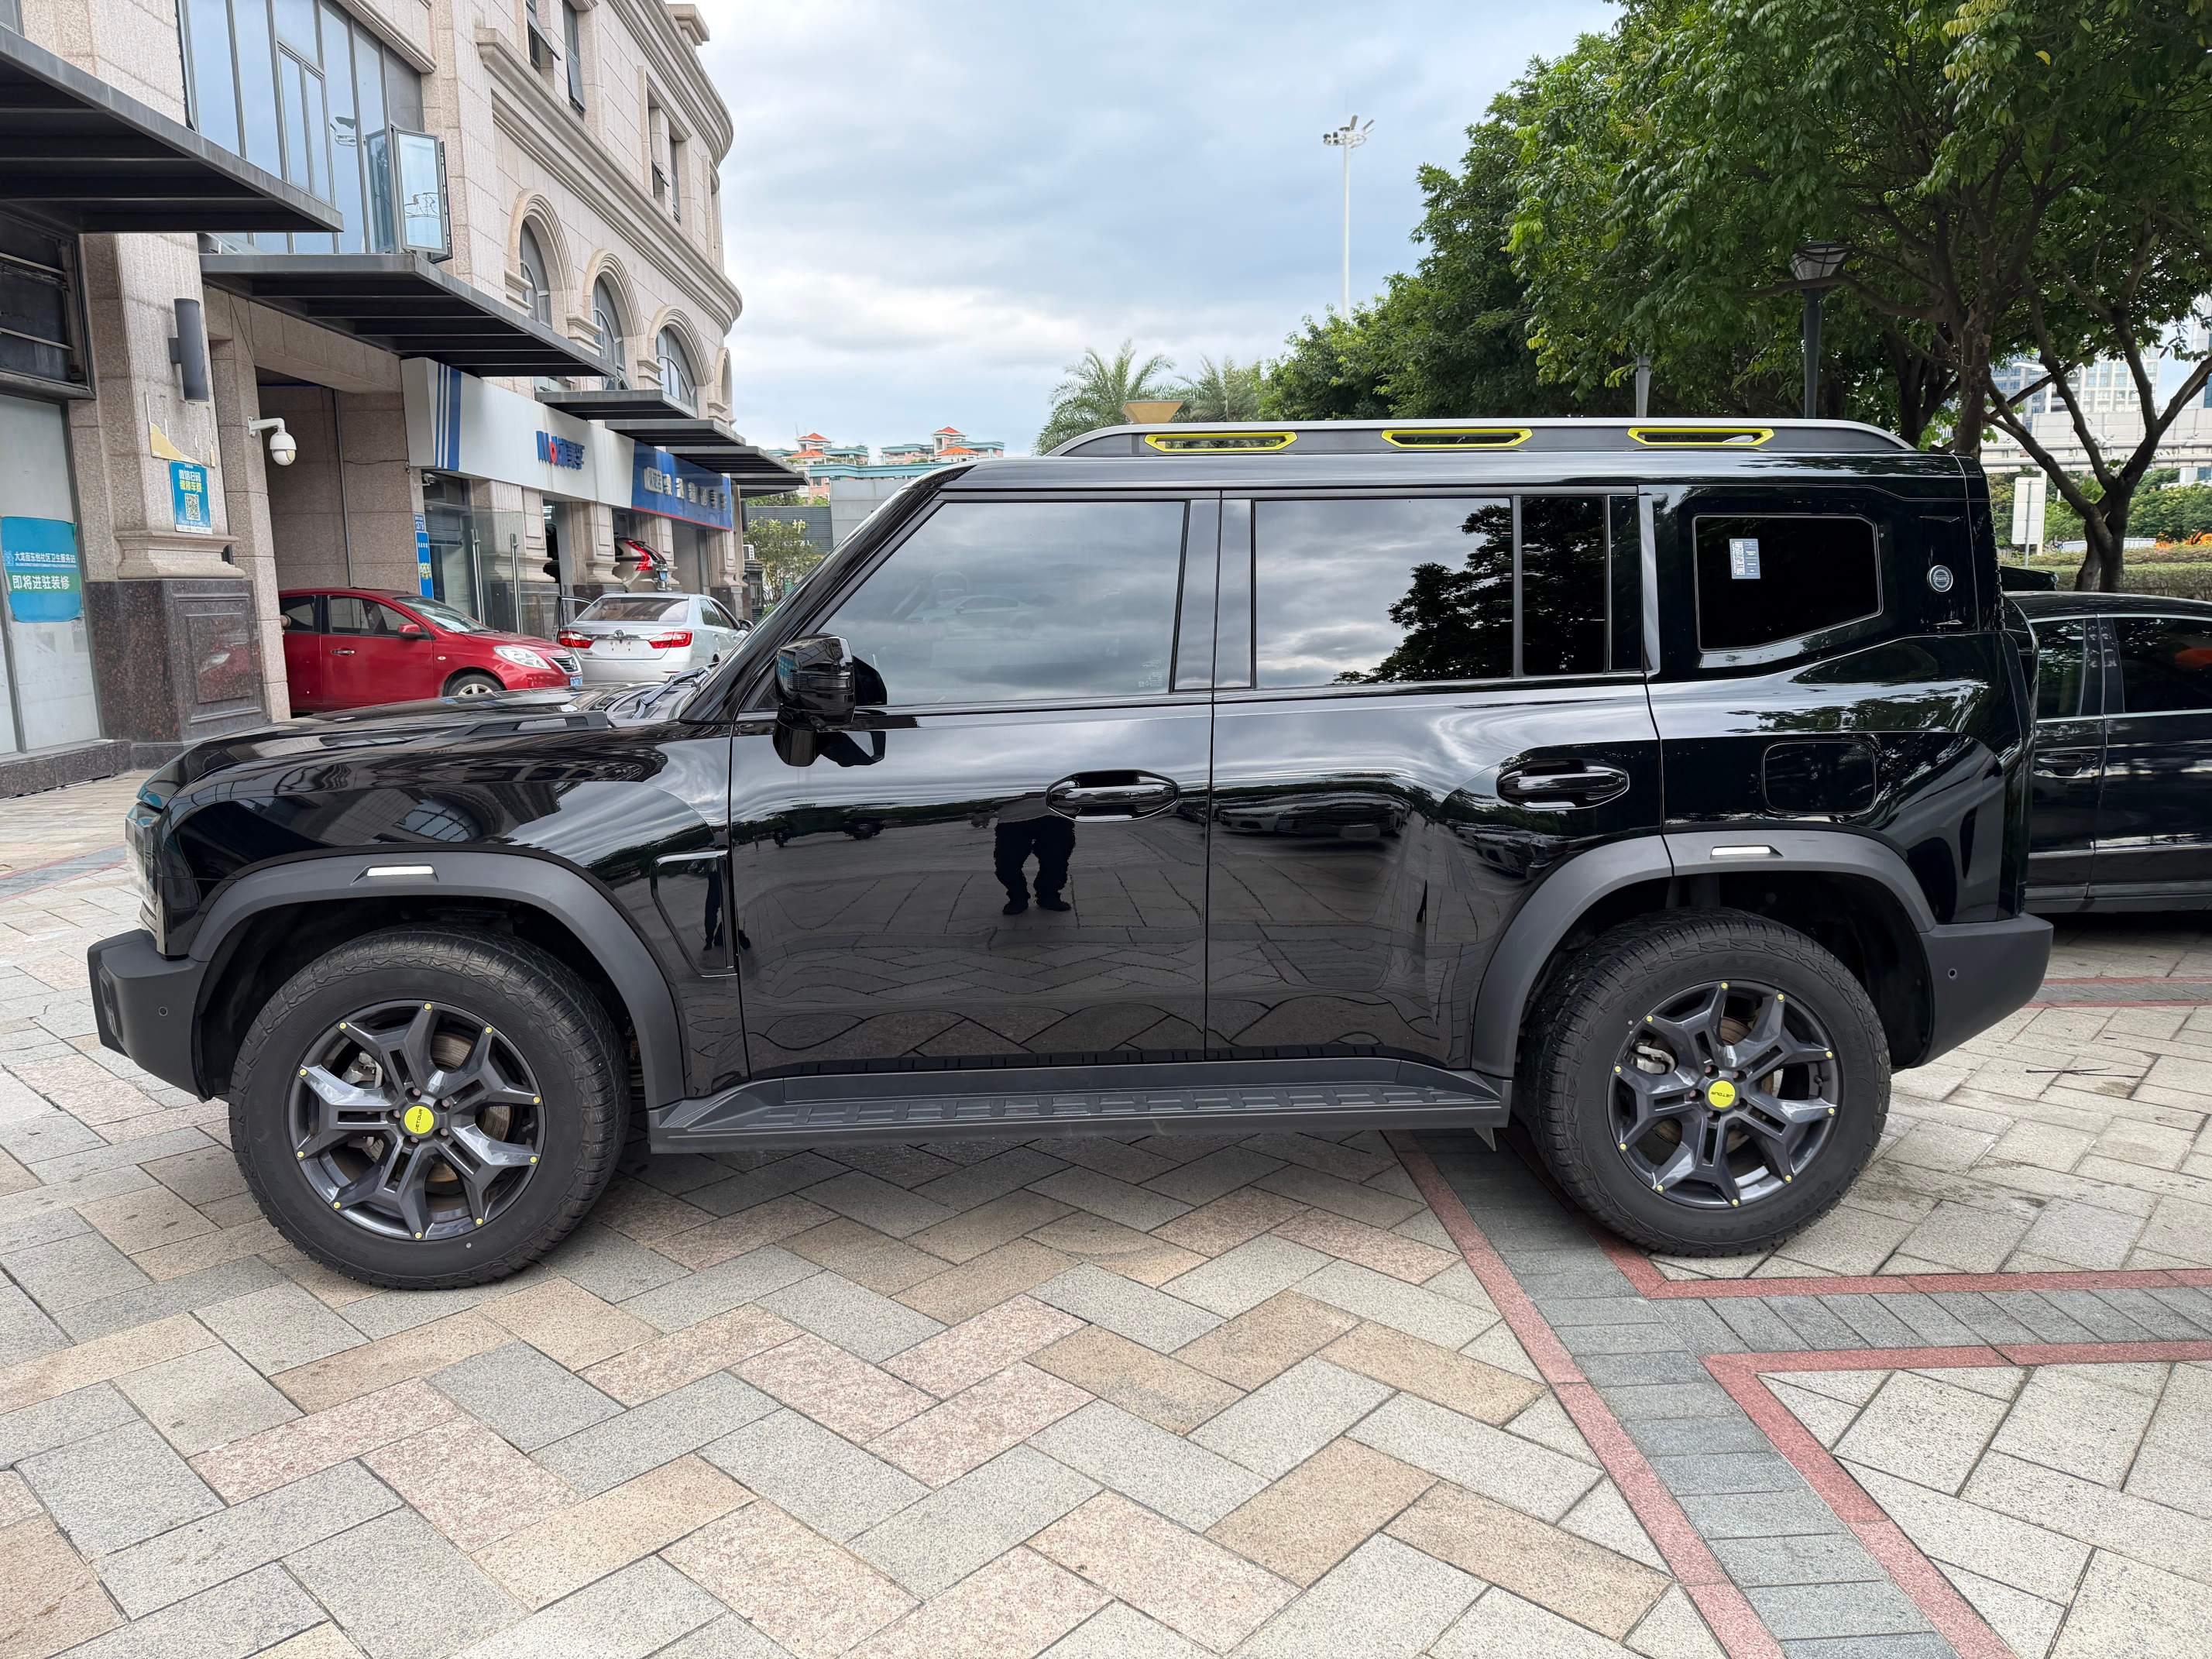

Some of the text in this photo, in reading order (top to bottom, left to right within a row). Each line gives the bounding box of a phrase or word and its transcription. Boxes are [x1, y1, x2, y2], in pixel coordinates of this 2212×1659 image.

[12, 575, 70, 590] 即将进驻装修
